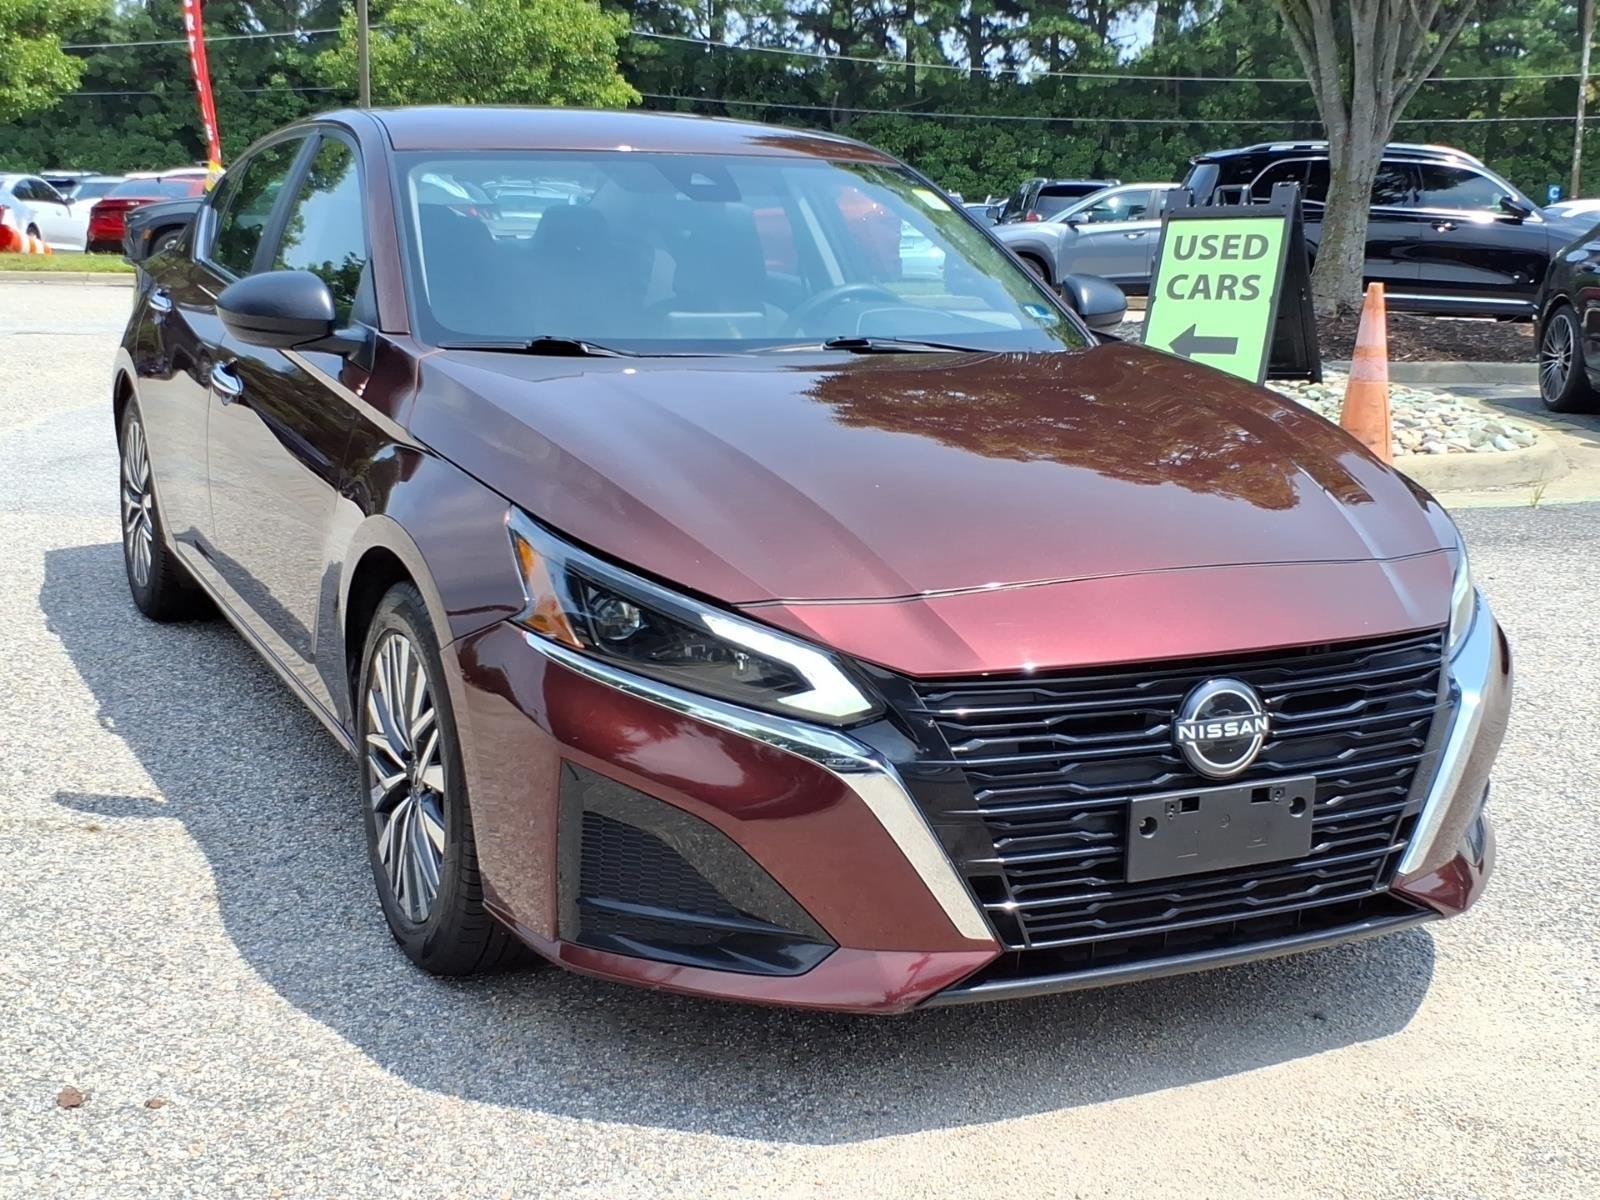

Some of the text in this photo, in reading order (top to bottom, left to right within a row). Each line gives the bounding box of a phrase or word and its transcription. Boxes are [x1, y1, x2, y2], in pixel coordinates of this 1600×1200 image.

[1173, 234, 1270, 261] USED
[1166, 274, 1262, 301] CARS
[1178, 716, 1268, 740] NISSAN
